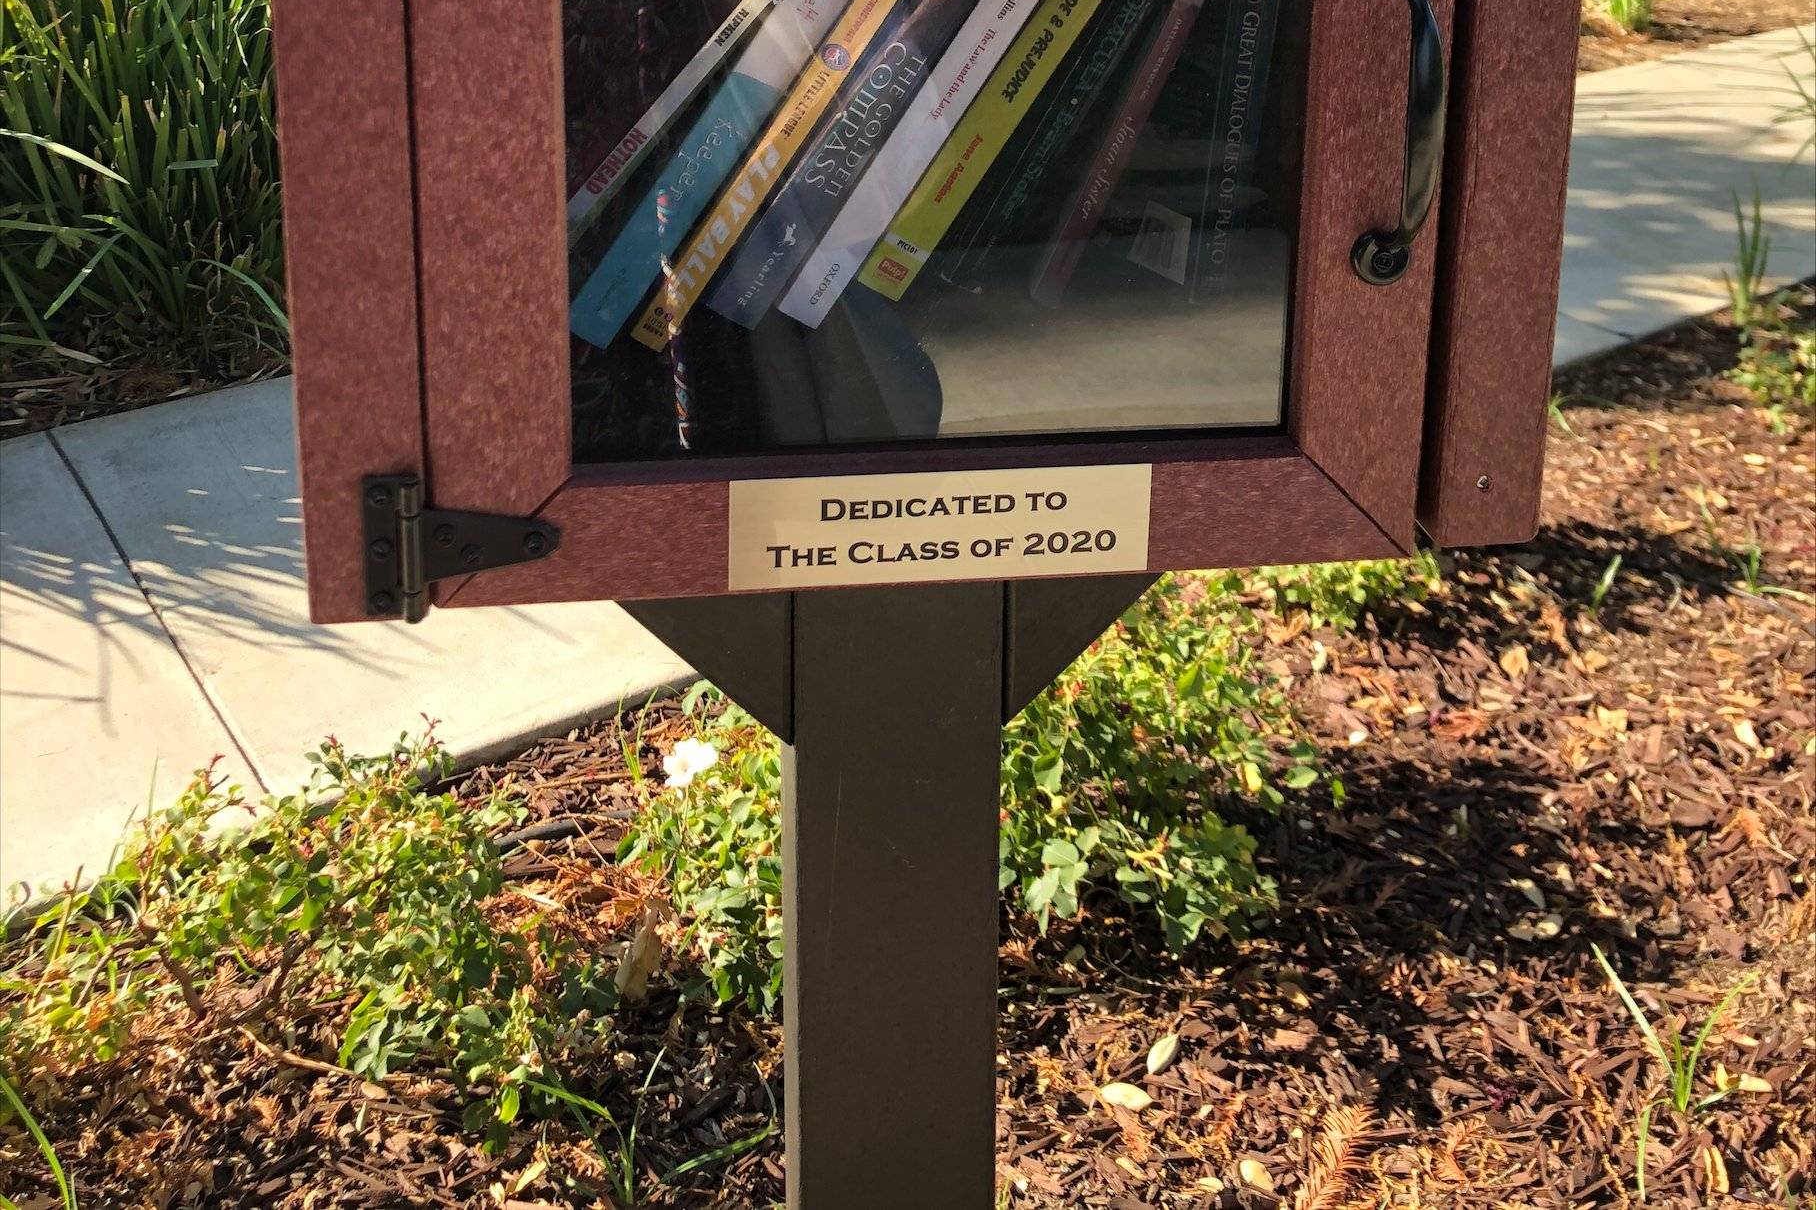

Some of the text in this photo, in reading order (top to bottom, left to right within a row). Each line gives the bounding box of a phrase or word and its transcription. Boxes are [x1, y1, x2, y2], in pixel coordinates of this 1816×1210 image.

[712, 7, 749, 47] RIPKEN
[978, 25, 997, 47] The
[1047, 12, 1065, 30] &
[1235, 10, 1259, 69] GREAT
[885, 49, 927, 101] THE
[954, 59, 975, 84] and
[999, 26, 1056, 104] PREJUDICE
[927, 95, 951, 122] Lady
[943, 80, 962, 100] the
[804, 40, 908, 194] COMPASS
[1221, 72, 1251, 174] DIALOGUES
[960, 132, 985, 162] Jane
[718, 139, 784, 224] PLAY
[807, 260, 841, 307] OXFORD
[820, 492, 1067, 521] DEDICATED TO
[766, 529, 1117, 568] THE CLASS OF 2020
